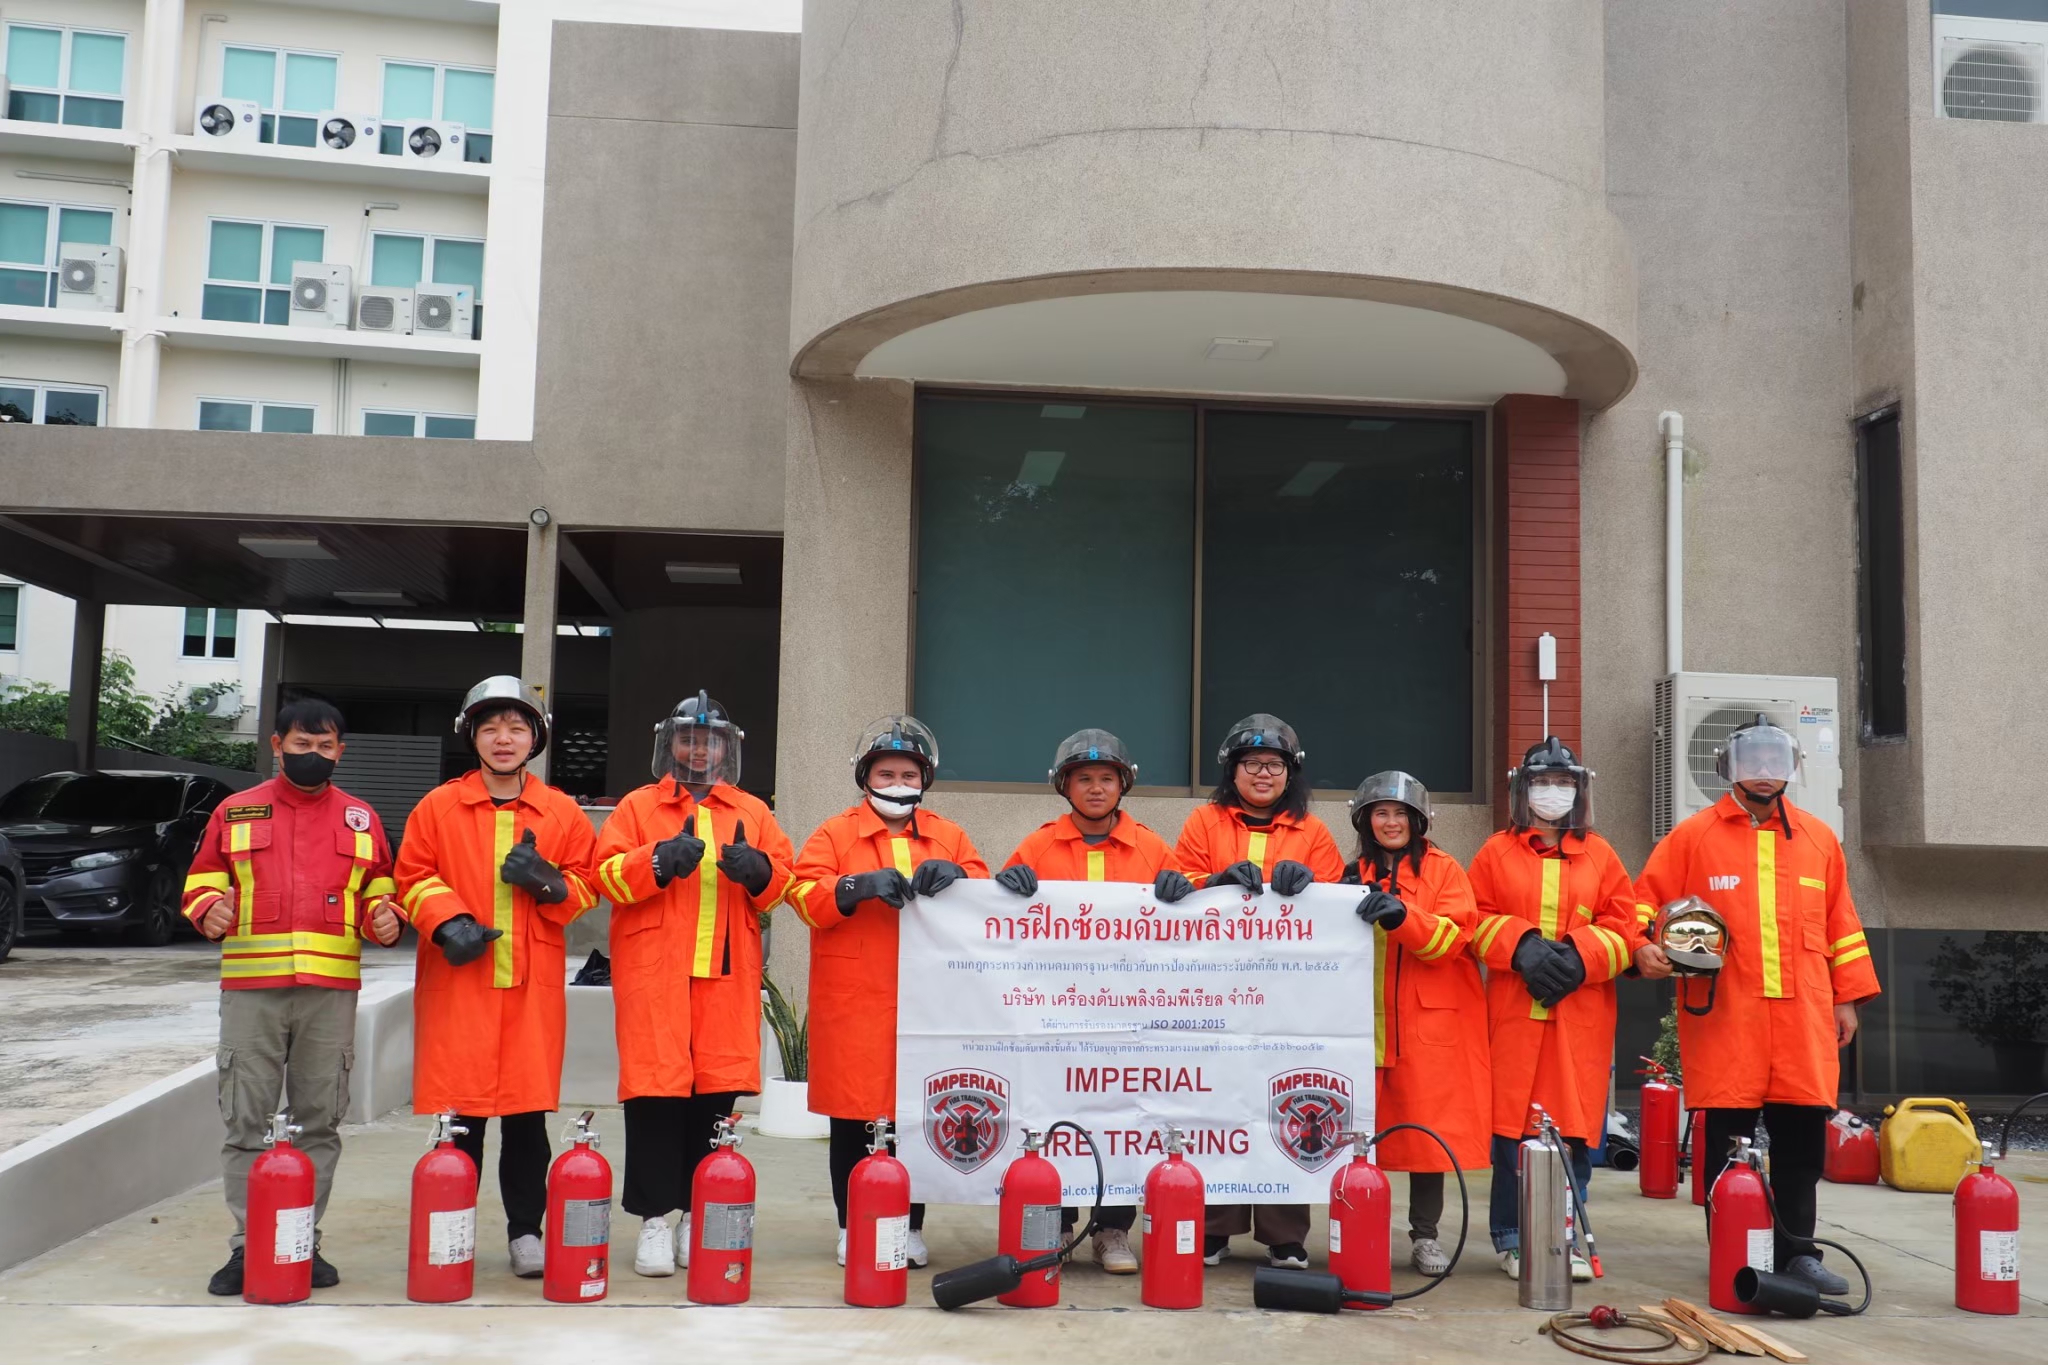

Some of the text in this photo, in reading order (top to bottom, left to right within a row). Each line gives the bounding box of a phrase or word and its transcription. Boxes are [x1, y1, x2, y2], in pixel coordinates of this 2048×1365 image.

[698, 713, 705, 724] 1
[892, 740, 901, 750] 5
[1253, 735, 1262, 746] 2
[1088, 747, 1098, 760] 8
[1708, 875, 1741, 891] IMP
[985, 894, 1313, 942] การฝึกซ้อมดับเพลิงขั้นต้น
[1281, 961, 1302, 972] พ.ศ.
[1002, 983, 1265, 1007] บริษัท เครื่องดับเพลิงอิมพีเรียล จำกัด
[1150, 1019, 1169, 1030] ISO
[1171, 1018, 1226, 1030] 2001:2015
[928, 1072, 1007, 1099] IMPERIAL
[1065, 1066, 1213, 1093] IMPERIAL
[1272, 1072, 1350, 1098] IMPERIAL
[948, 1094, 986, 1107] FIRE TRAINING
[1292, 1094, 1330, 1106] FIRE TRAINING
